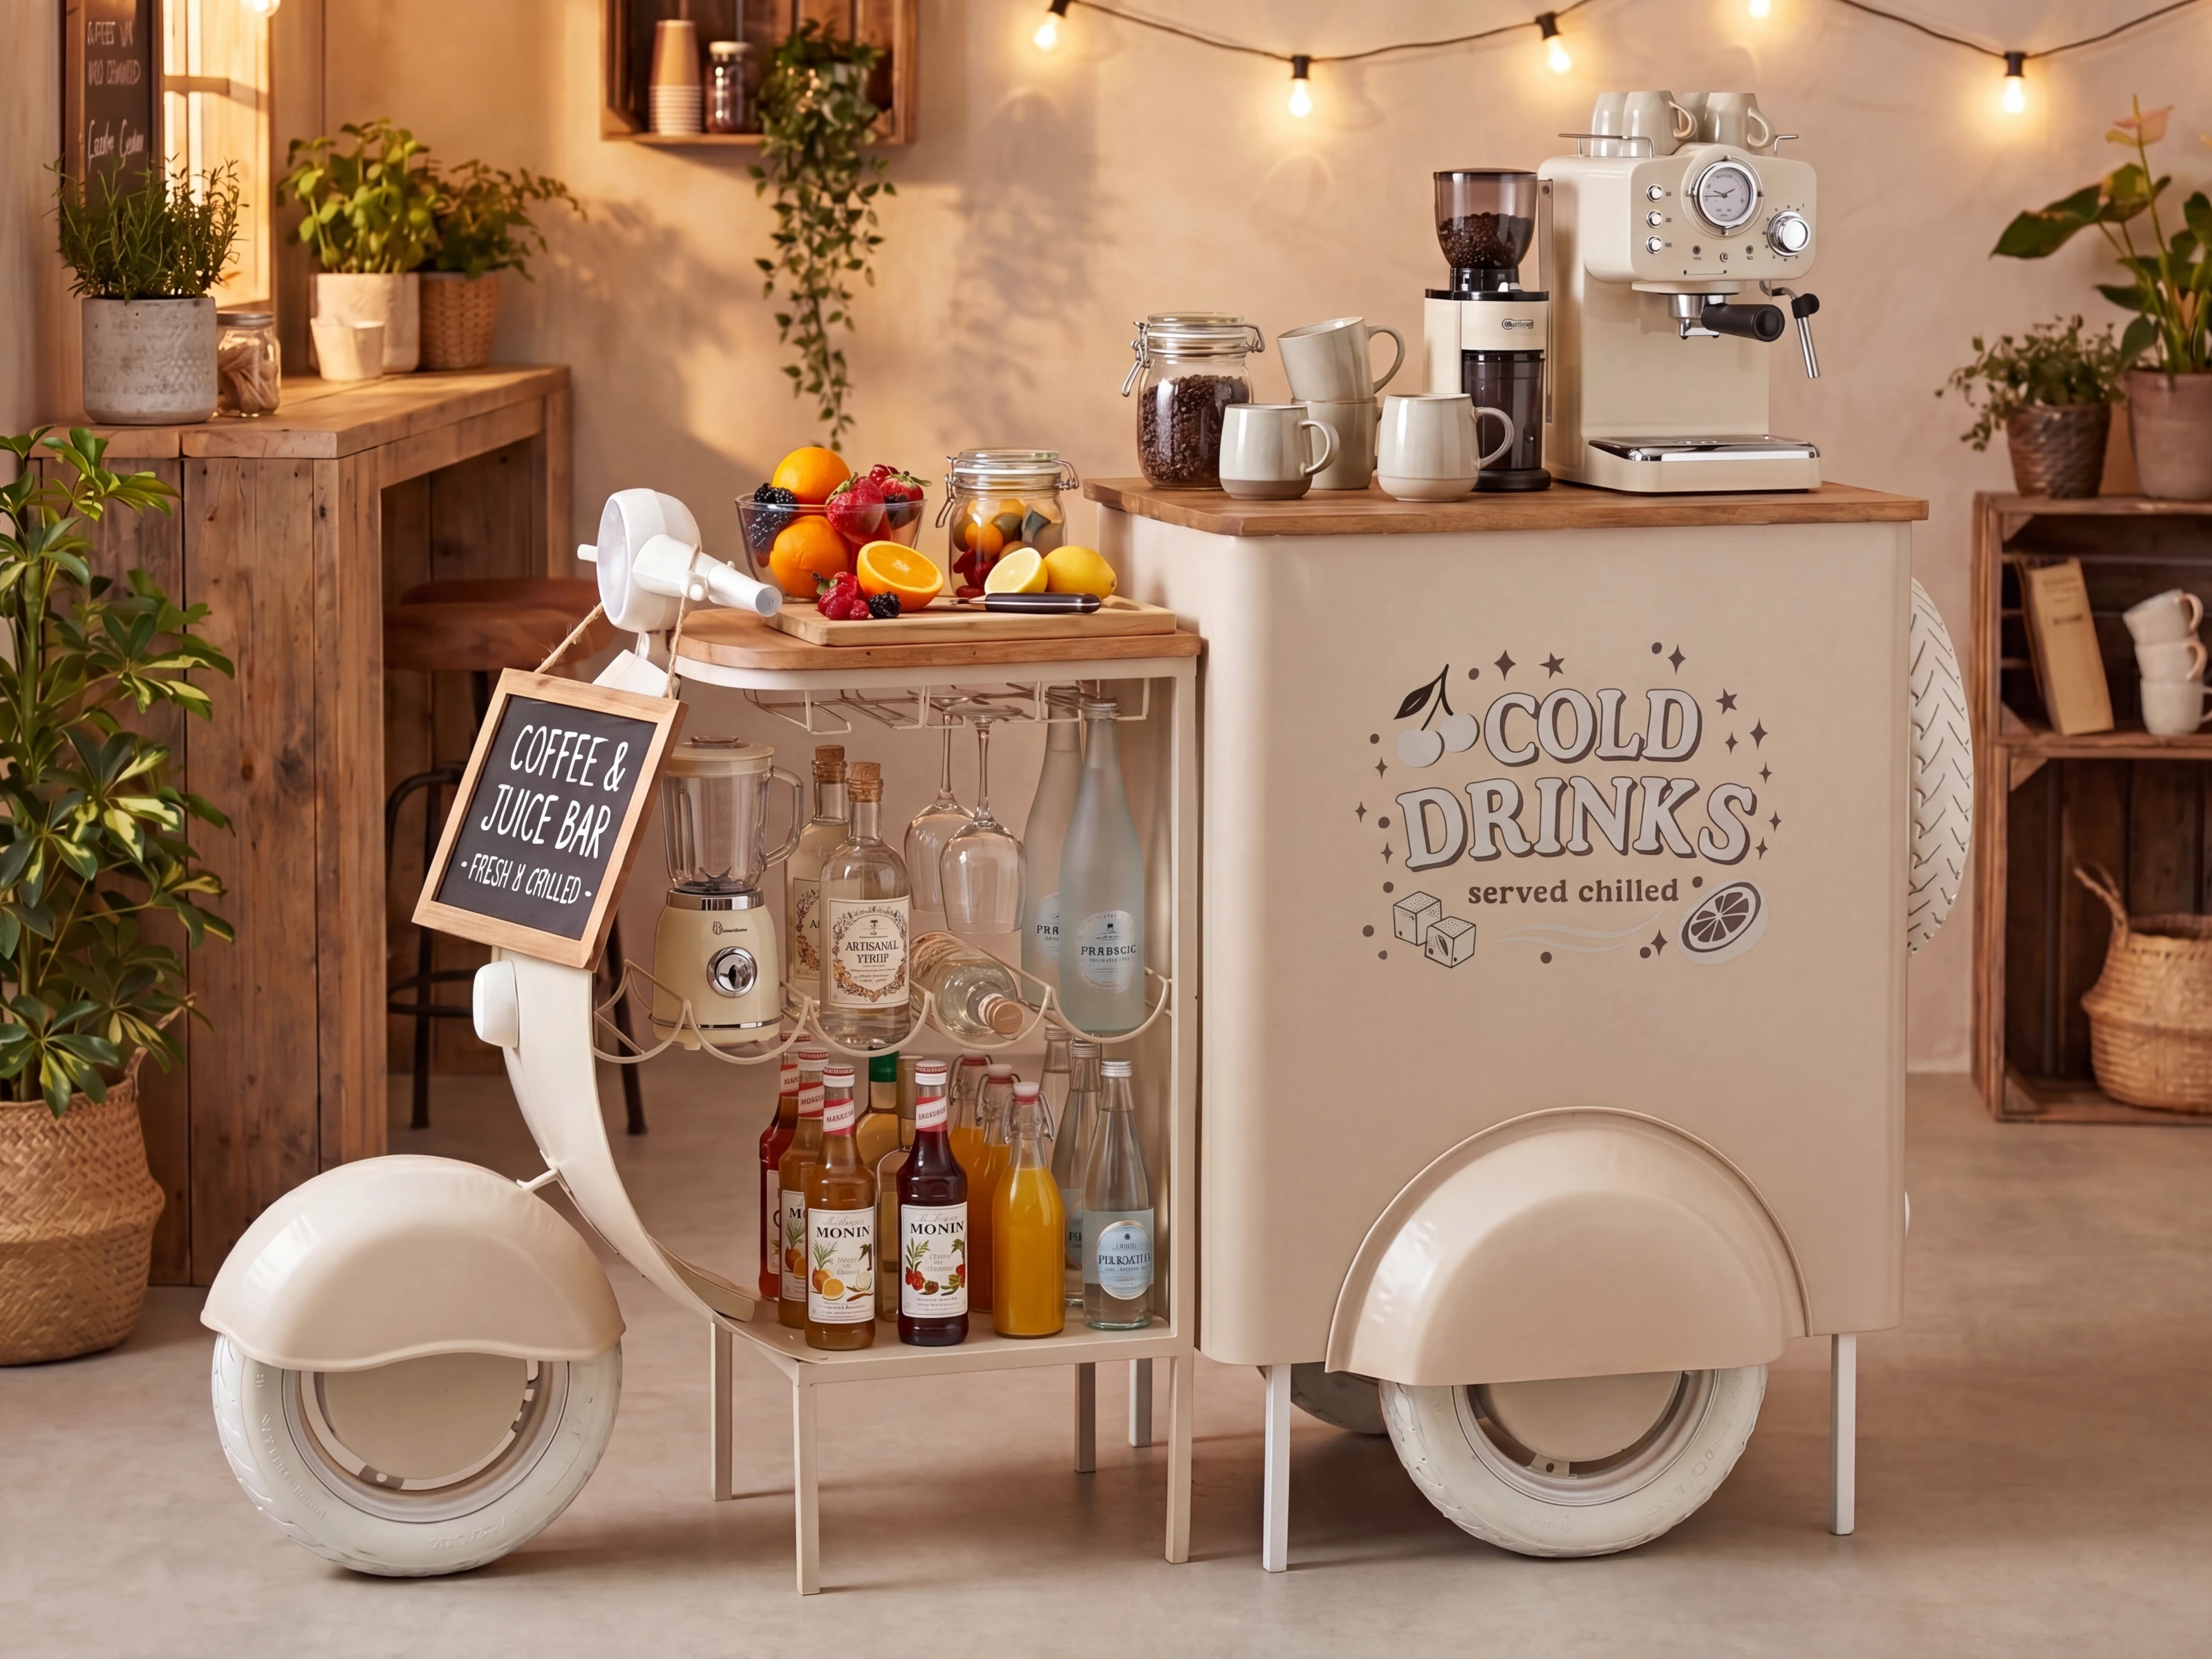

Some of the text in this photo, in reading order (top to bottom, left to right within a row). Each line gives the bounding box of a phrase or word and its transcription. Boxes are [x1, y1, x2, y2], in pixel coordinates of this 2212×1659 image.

[1483, 688, 1703, 767] COLD
[510, 724, 629, 792] COFFEE &
[480, 784, 611, 859] JUICE BAR
[1396, 776, 1757, 872] DRINKS
[468, 853, 514, 889] FRESH
[1468, 879, 1679, 904] served chilled
[816, 1225, 870, 1239] MONIN
[910, 1221, 964, 1235] MONIN
